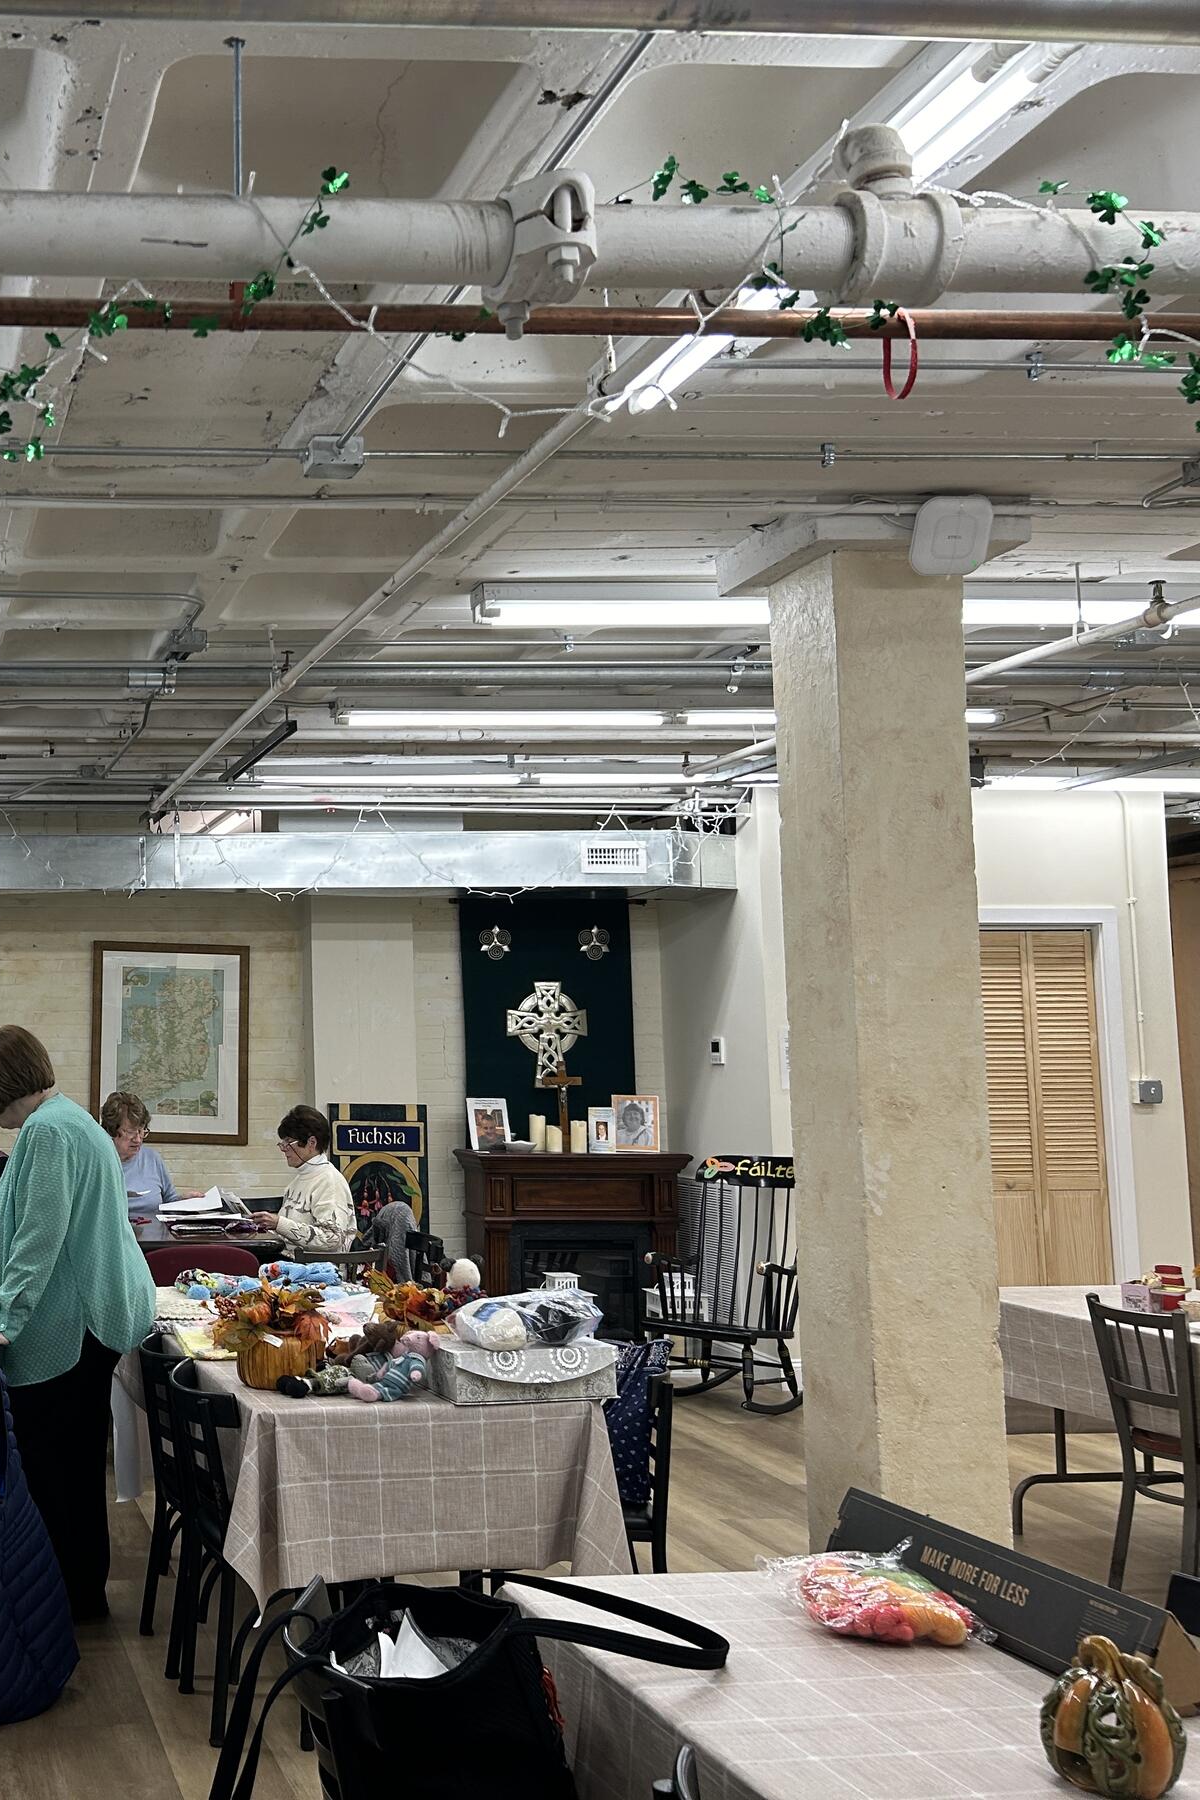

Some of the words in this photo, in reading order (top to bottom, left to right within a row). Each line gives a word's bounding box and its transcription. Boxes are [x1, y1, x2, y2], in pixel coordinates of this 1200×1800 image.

[347, 1127, 406, 1145] Fuchsia
[920, 1545, 951, 1573] MAKE
[948, 1558, 980, 1586] MORE
[978, 1569, 1001, 1595] FOR
[1000, 1580, 1030, 1607] LESS
